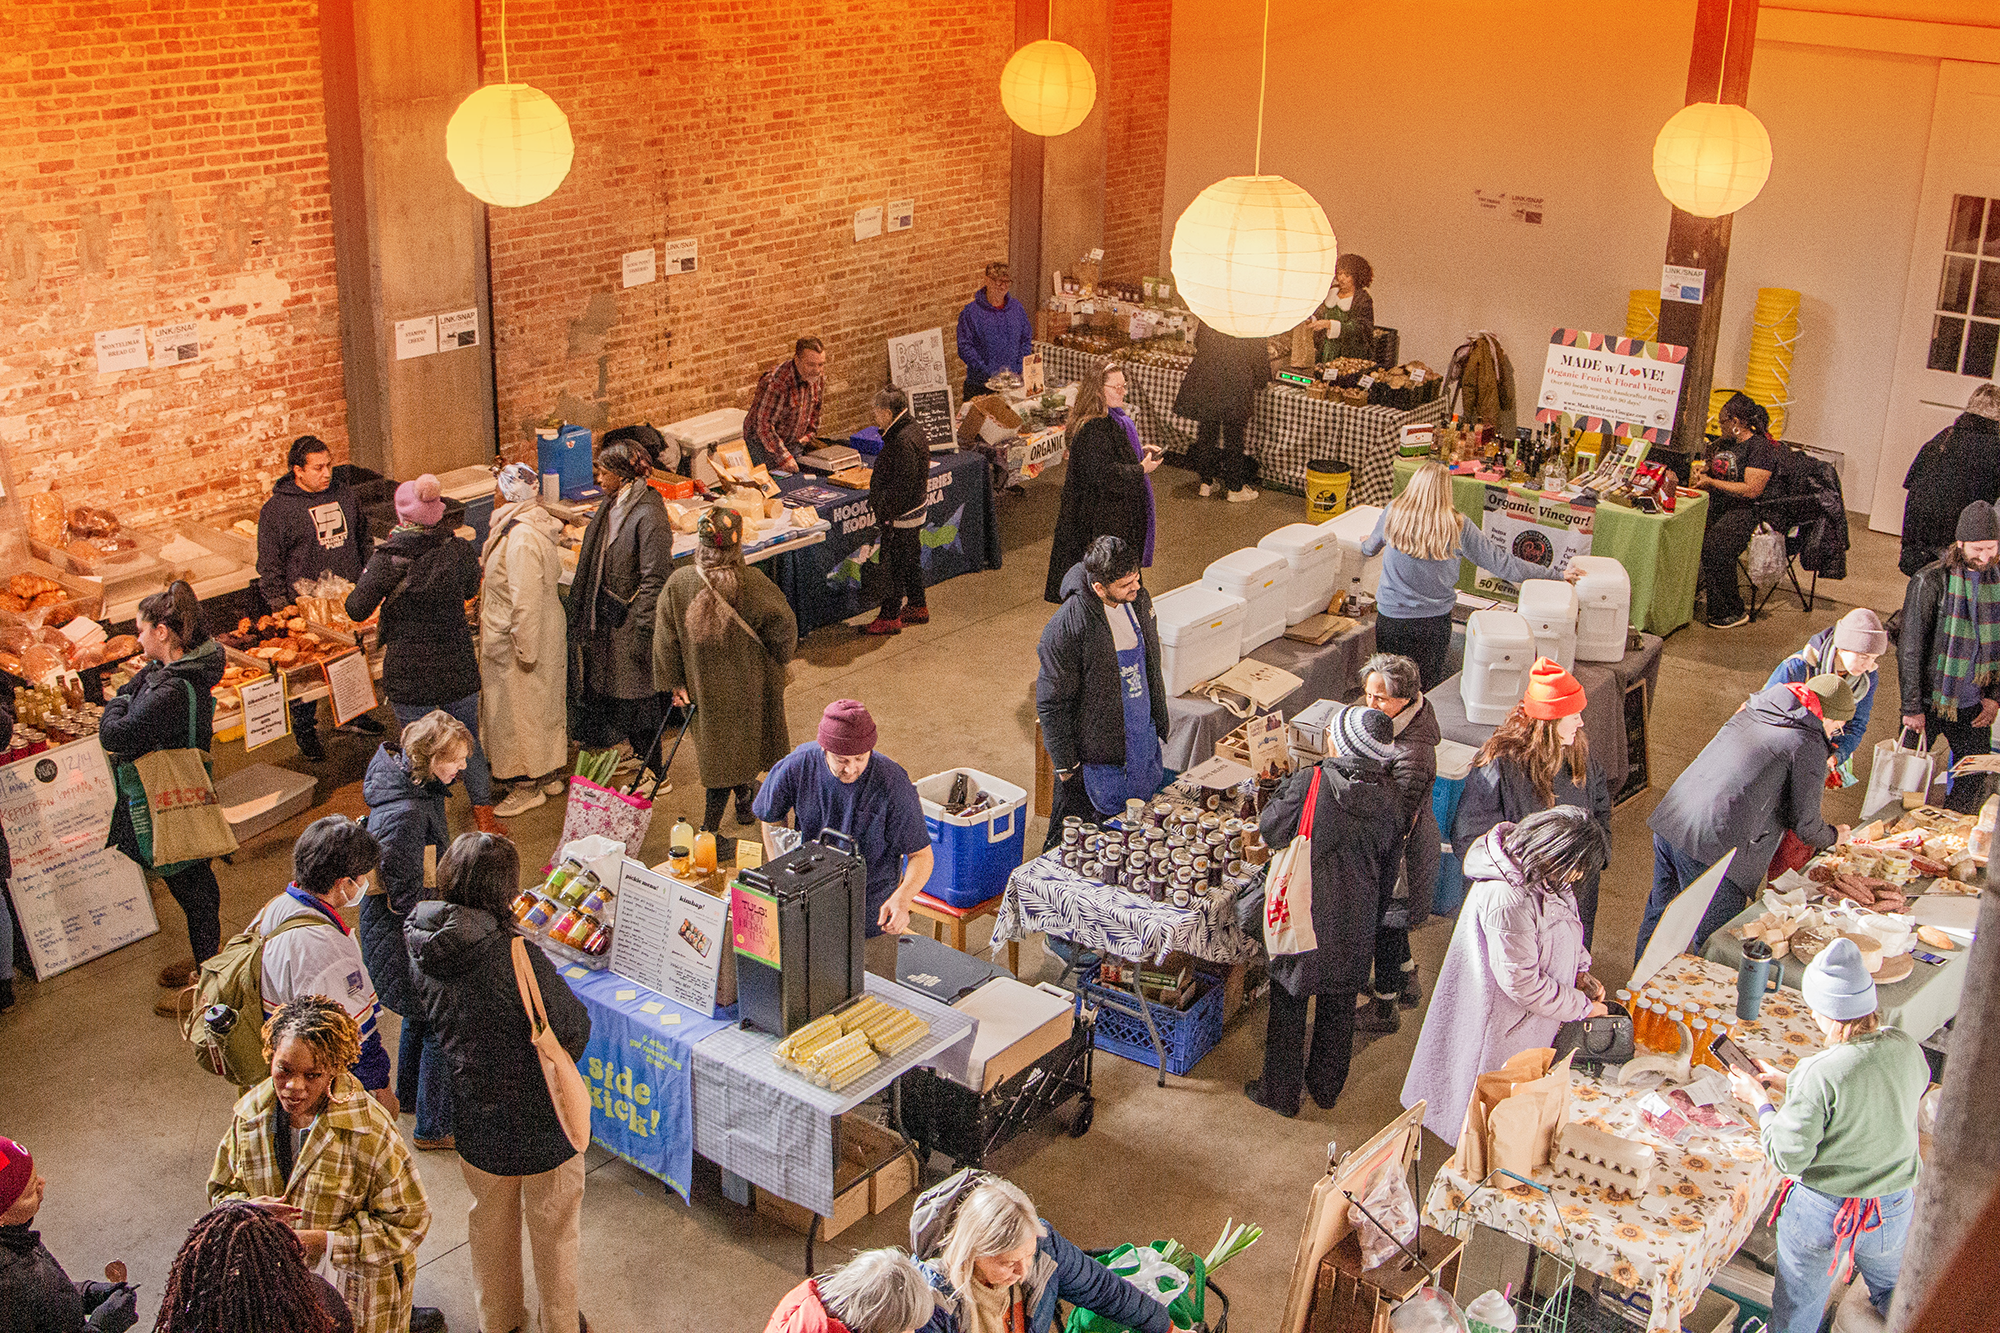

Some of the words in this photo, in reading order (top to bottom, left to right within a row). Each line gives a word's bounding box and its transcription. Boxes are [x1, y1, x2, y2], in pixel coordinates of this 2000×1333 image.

[667, 241, 696, 250] LINK/SNAP
[1665, 266, 1703, 277] LINK/SNAP
[440, 312, 476, 324] LINK/SNAP
[154, 323, 198, 337] LINK/SNAP
[101, 340, 140, 350] MONTELIMAR
[108, 349, 128, 357] BREAD
[1560, 354, 1602, 371] MADE
[1547, 367, 1579, 381] Organic
[1581, 372, 1603, 383] Fruit
[1604, 376, 1613, 385] &
[1615, 377, 1641, 390] Floral
[1642, 384, 1676, 396] Vinegar
[1571, 390, 1600, 399] fermented
[1627, 398, 1641, 407] days!
[1572, 382, 1589, 391] locally
[1613, 389, 1647, 400] handcrafted
[1030, 434, 1063, 460] ORGANIC
[833, 500, 869, 522] HOOK
[1488, 494, 1536, 514] Organic
[1539, 506, 1591, 526] Vinegar!
[1565, 546, 1577, 554] Jerk
[1478, 579, 1492, 589] 50
[625, 874, 642, 884] pickle
[641, 880, 660, 891] menu!
[679, 895, 706, 911] kimbap!
[744, 910, 764, 926] HOT
[749, 930, 765, 945] TEA
[588, 1056, 651, 1106] side
[582, 1075, 660, 1138] kick!
